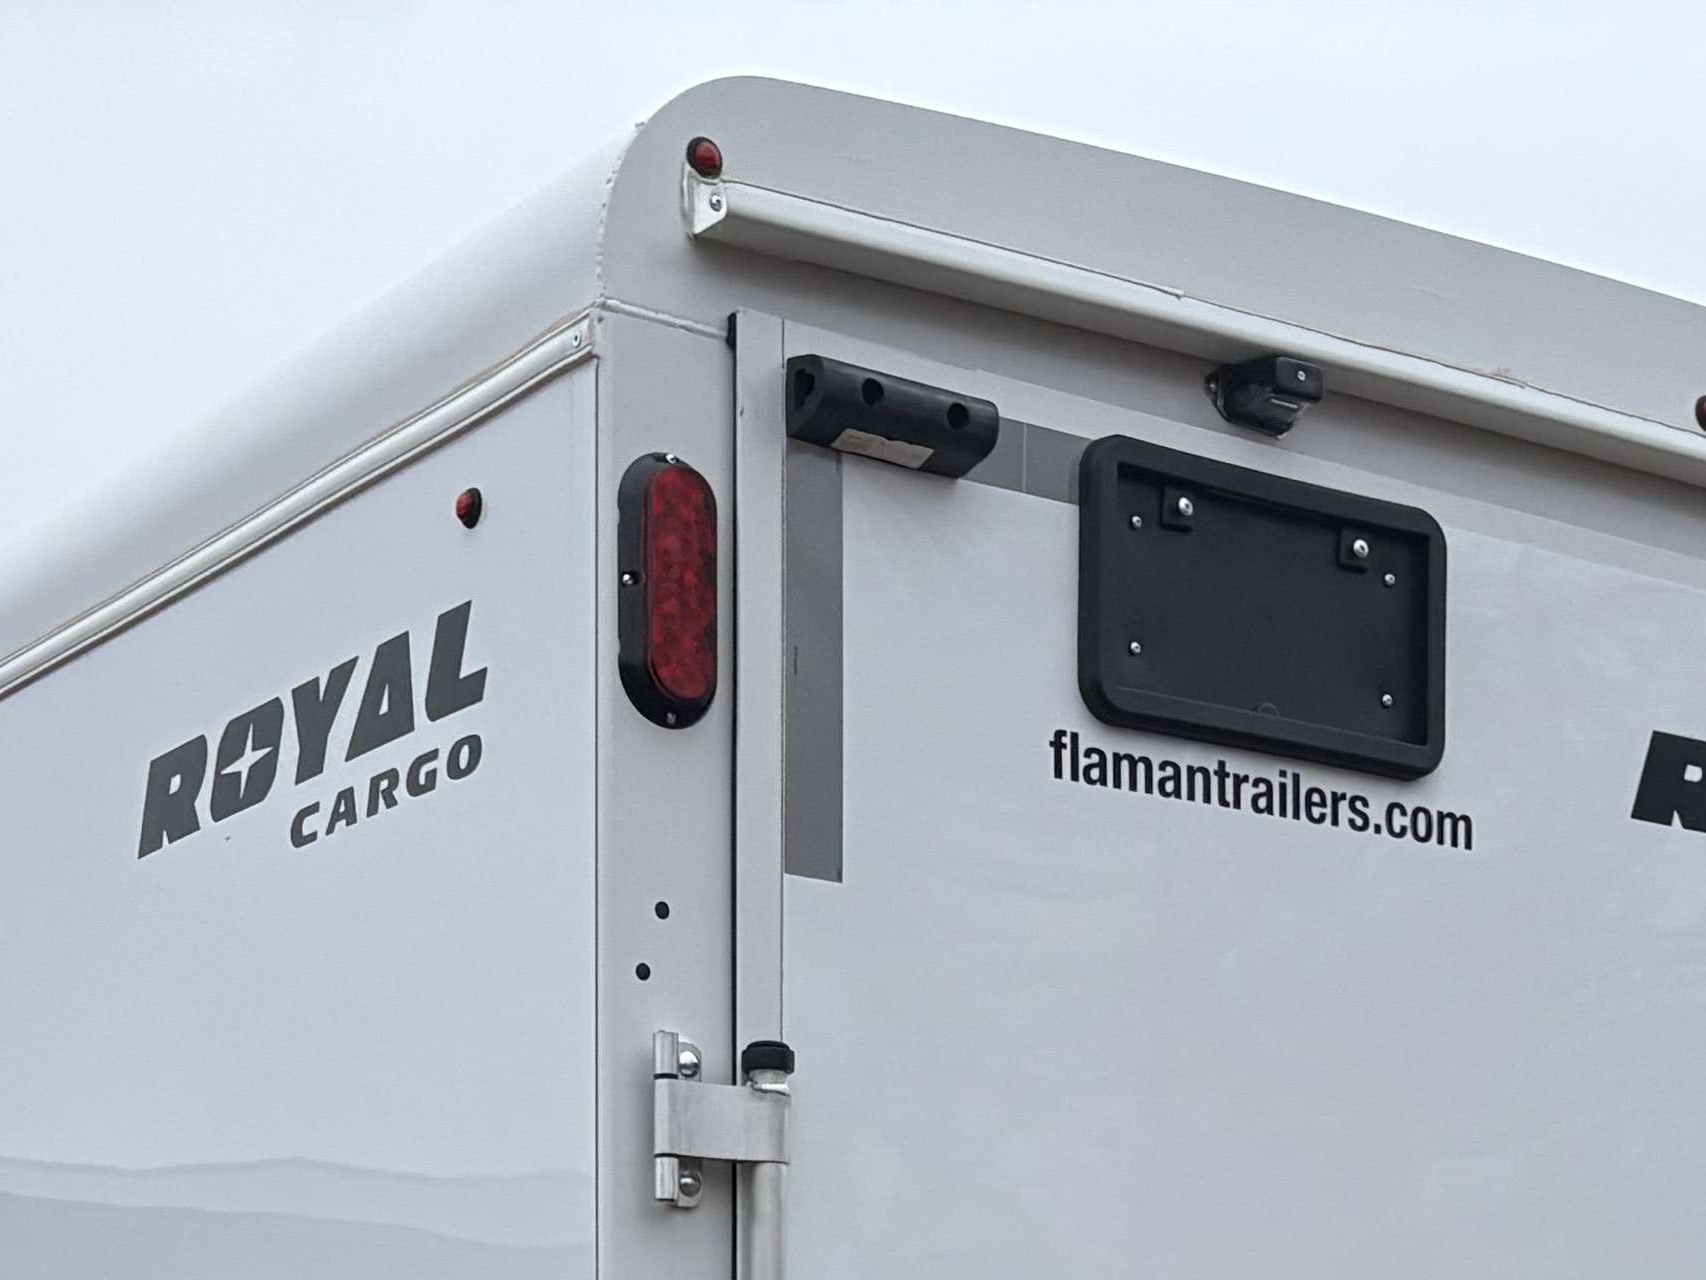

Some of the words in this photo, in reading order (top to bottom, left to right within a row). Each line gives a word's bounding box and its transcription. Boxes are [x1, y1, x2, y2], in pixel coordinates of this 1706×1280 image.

[137, 599, 488, 860] ROYAL
[1048, 729, 1473, 851] flamantrailers.com
[289, 733, 483, 849] CARGO
